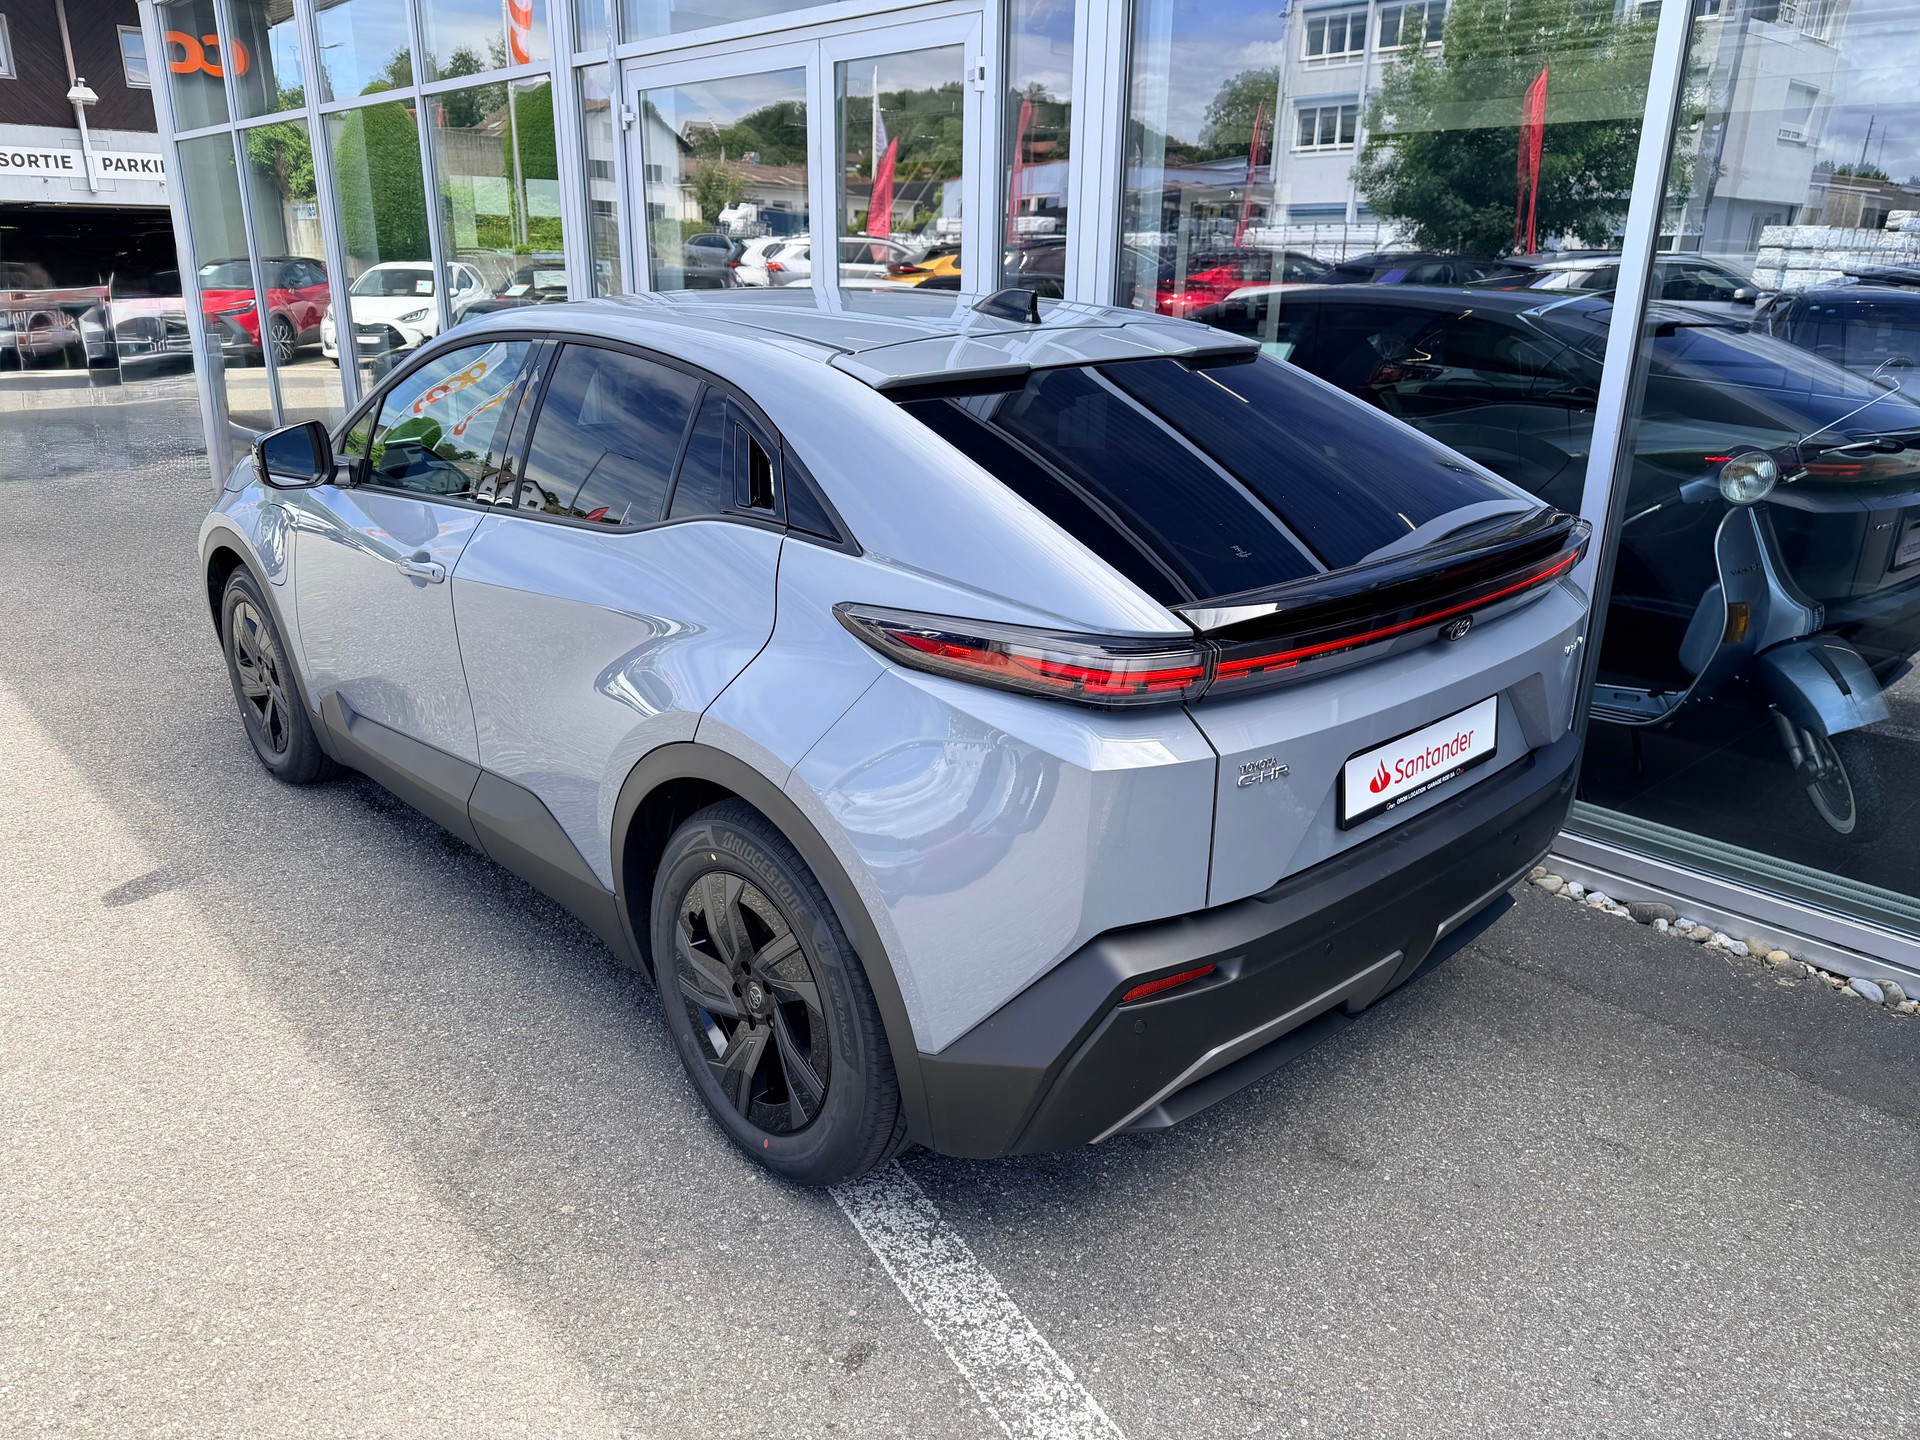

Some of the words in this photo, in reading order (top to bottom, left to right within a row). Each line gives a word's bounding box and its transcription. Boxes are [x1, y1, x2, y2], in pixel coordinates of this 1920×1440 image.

[0, 152, 73, 169] SORTIE
[1237, 764, 1290, 787] C-HR
[1239, 756, 1277, 774] TOYOTA
[1394, 730, 1474, 784] Santander
[722, 831, 807, 917] BRIDGESTONE
[829, 974, 851, 1057] TURANZA
